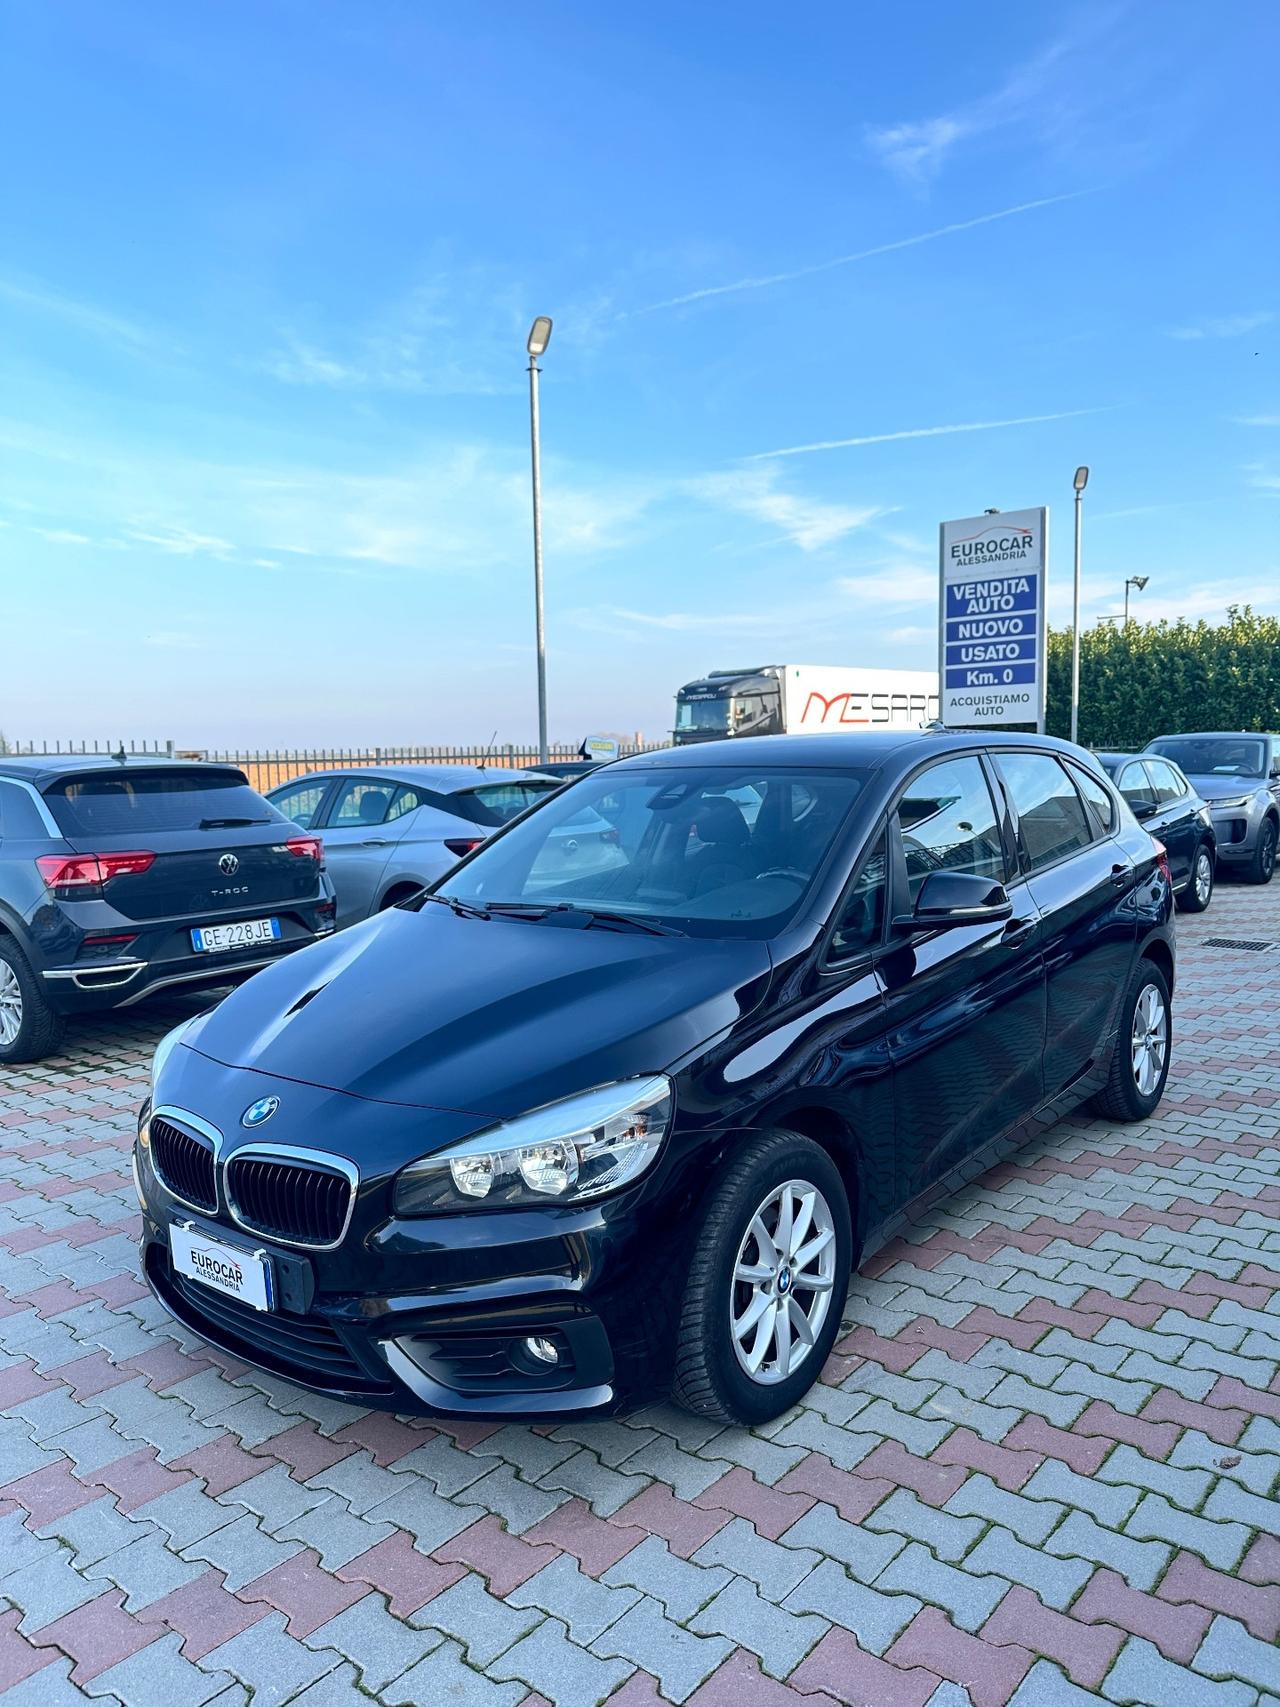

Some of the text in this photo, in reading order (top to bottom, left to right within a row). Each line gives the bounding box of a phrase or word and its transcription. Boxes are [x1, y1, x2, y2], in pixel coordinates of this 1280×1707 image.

[951, 535, 1033, 558] EUROCAR
[956, 550, 1027, 566] ALESSANDRIA
[953, 577, 1030, 600] VENDITA
[966, 595, 1015, 614] AUTO
[958, 618, 1023, 639] NUOVO
[961, 643, 1020, 663] USATO
[966, 668, 1014, 686] Km. 0
[950, 693, 1030, 707] ACQUISTIAMO
[974, 706, 1004, 717] AUTO
[211, 886, 249, 897] T-ROC
[190, 1250, 244, 1285] EUROCAR
[195, 1266, 241, 1293] ALESSANDRIA
